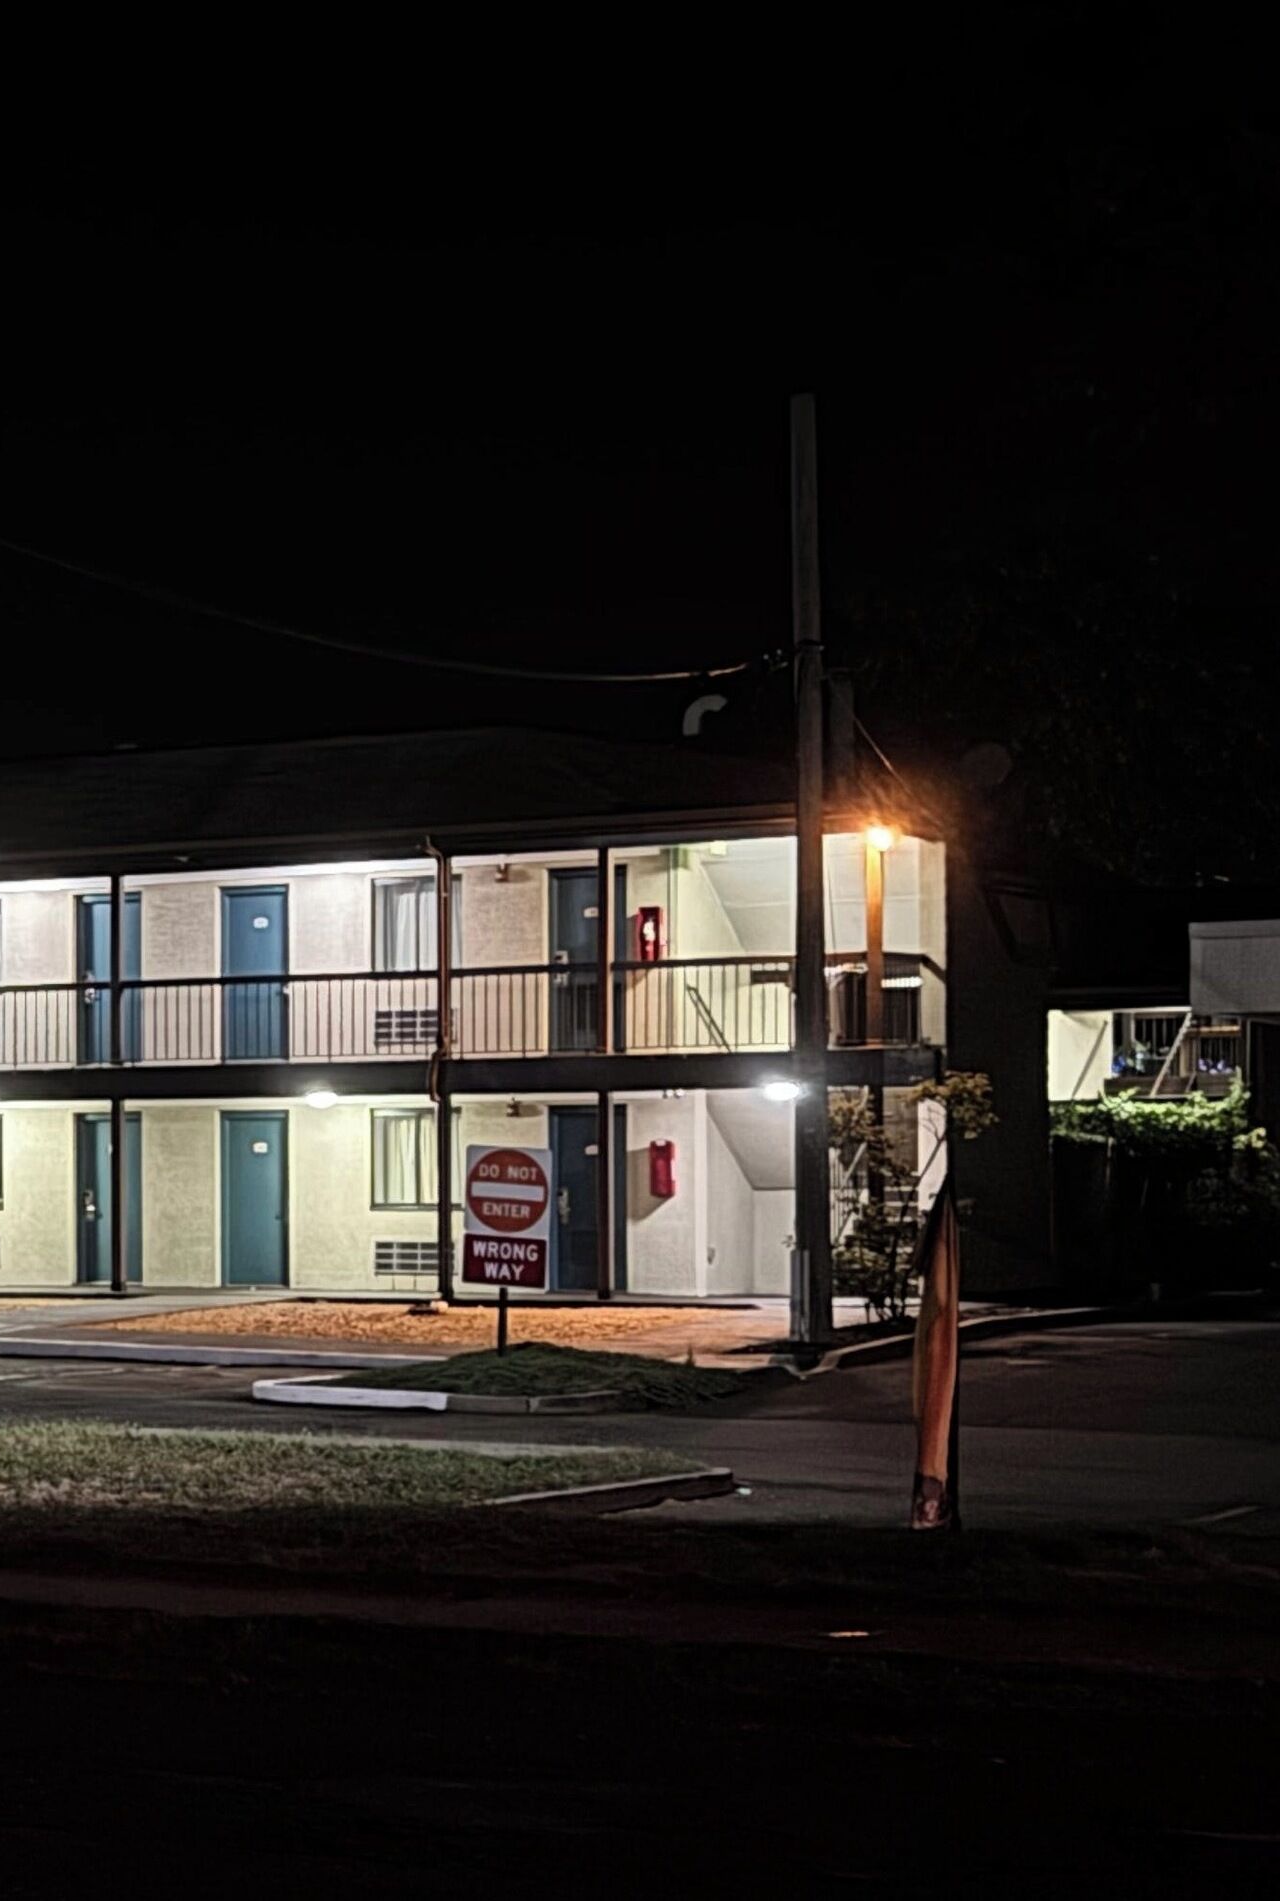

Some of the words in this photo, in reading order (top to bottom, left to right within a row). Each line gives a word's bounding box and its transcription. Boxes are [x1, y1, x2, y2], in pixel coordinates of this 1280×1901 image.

[479, 1164, 499, 1178] DO
[507, 1165, 538, 1181] NOT
[482, 1202, 531, 1218] ENTER
[473, 1240, 539, 1262] WRONG
[484, 1262, 524, 1281] WAY
